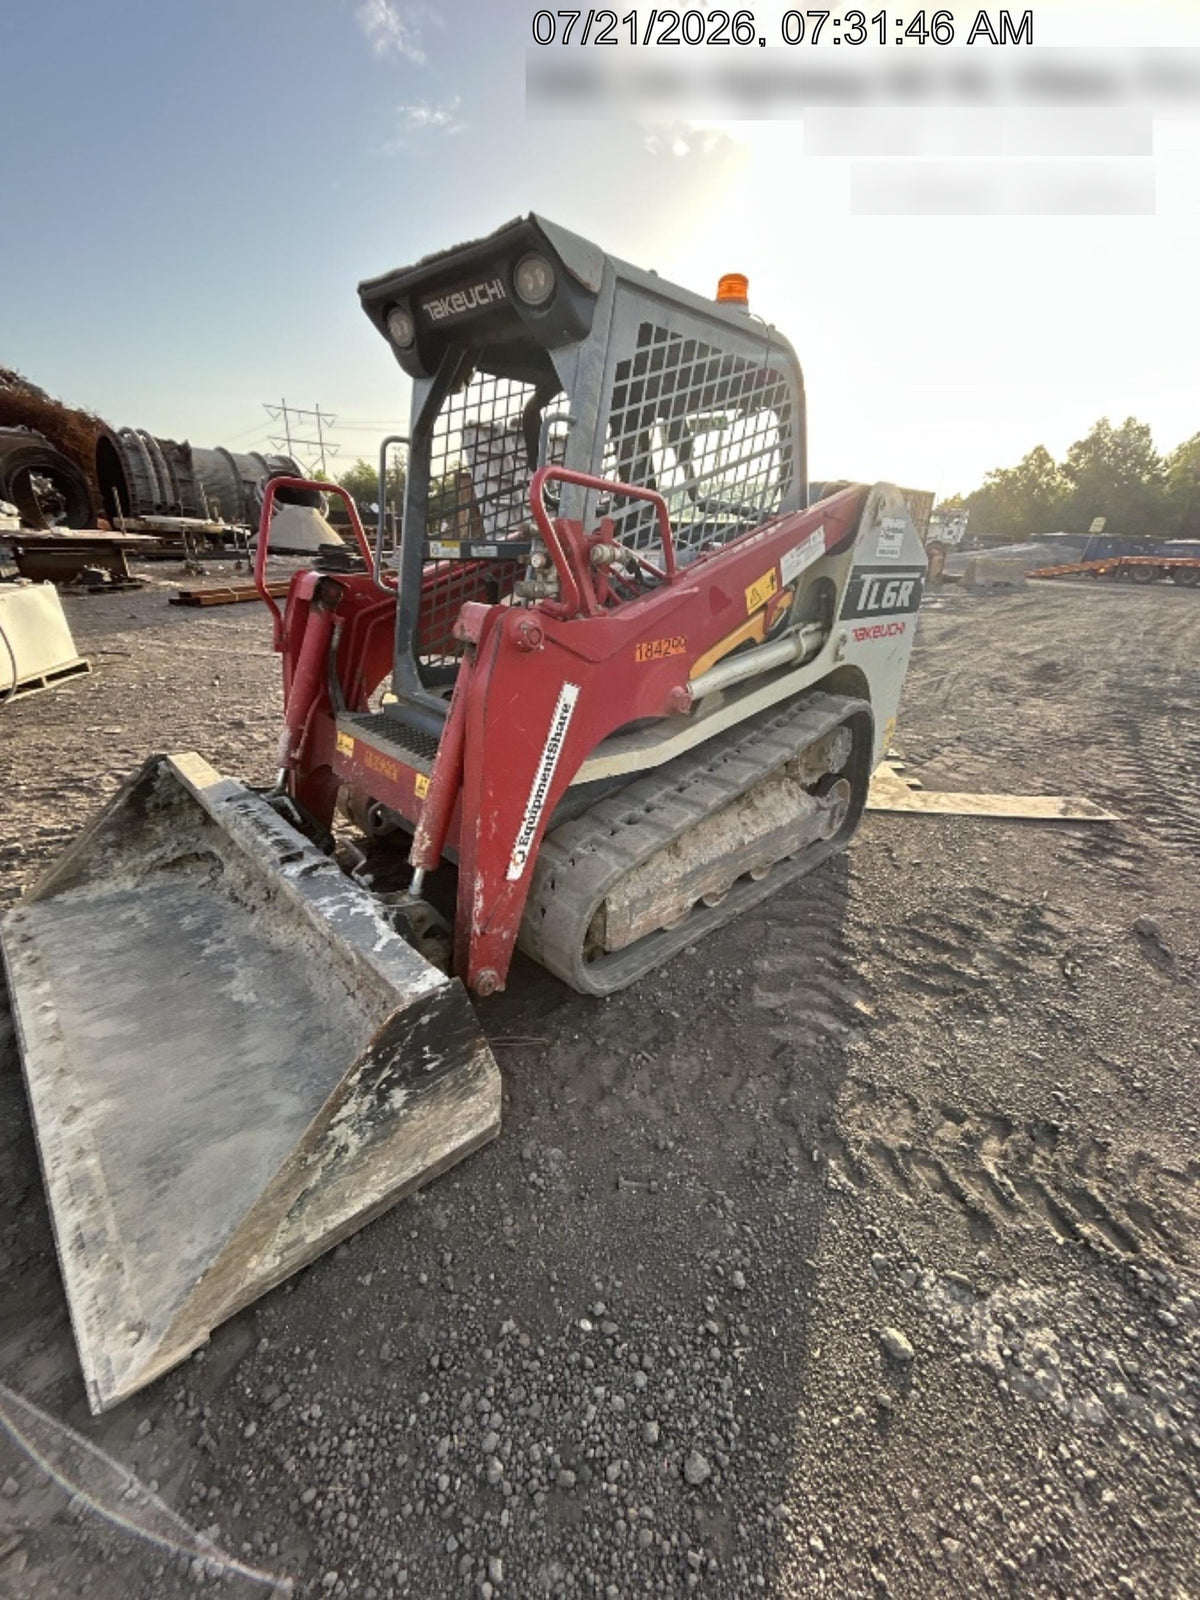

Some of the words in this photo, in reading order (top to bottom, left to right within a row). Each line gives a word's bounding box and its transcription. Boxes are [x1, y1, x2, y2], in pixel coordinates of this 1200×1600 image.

[422, 278, 506, 321] TAKEUCHI
[857, 572, 921, 611] TL6R
[852, 622, 906, 642] TAKEUCHI
[517, 702, 572, 846] EquipmentShare
